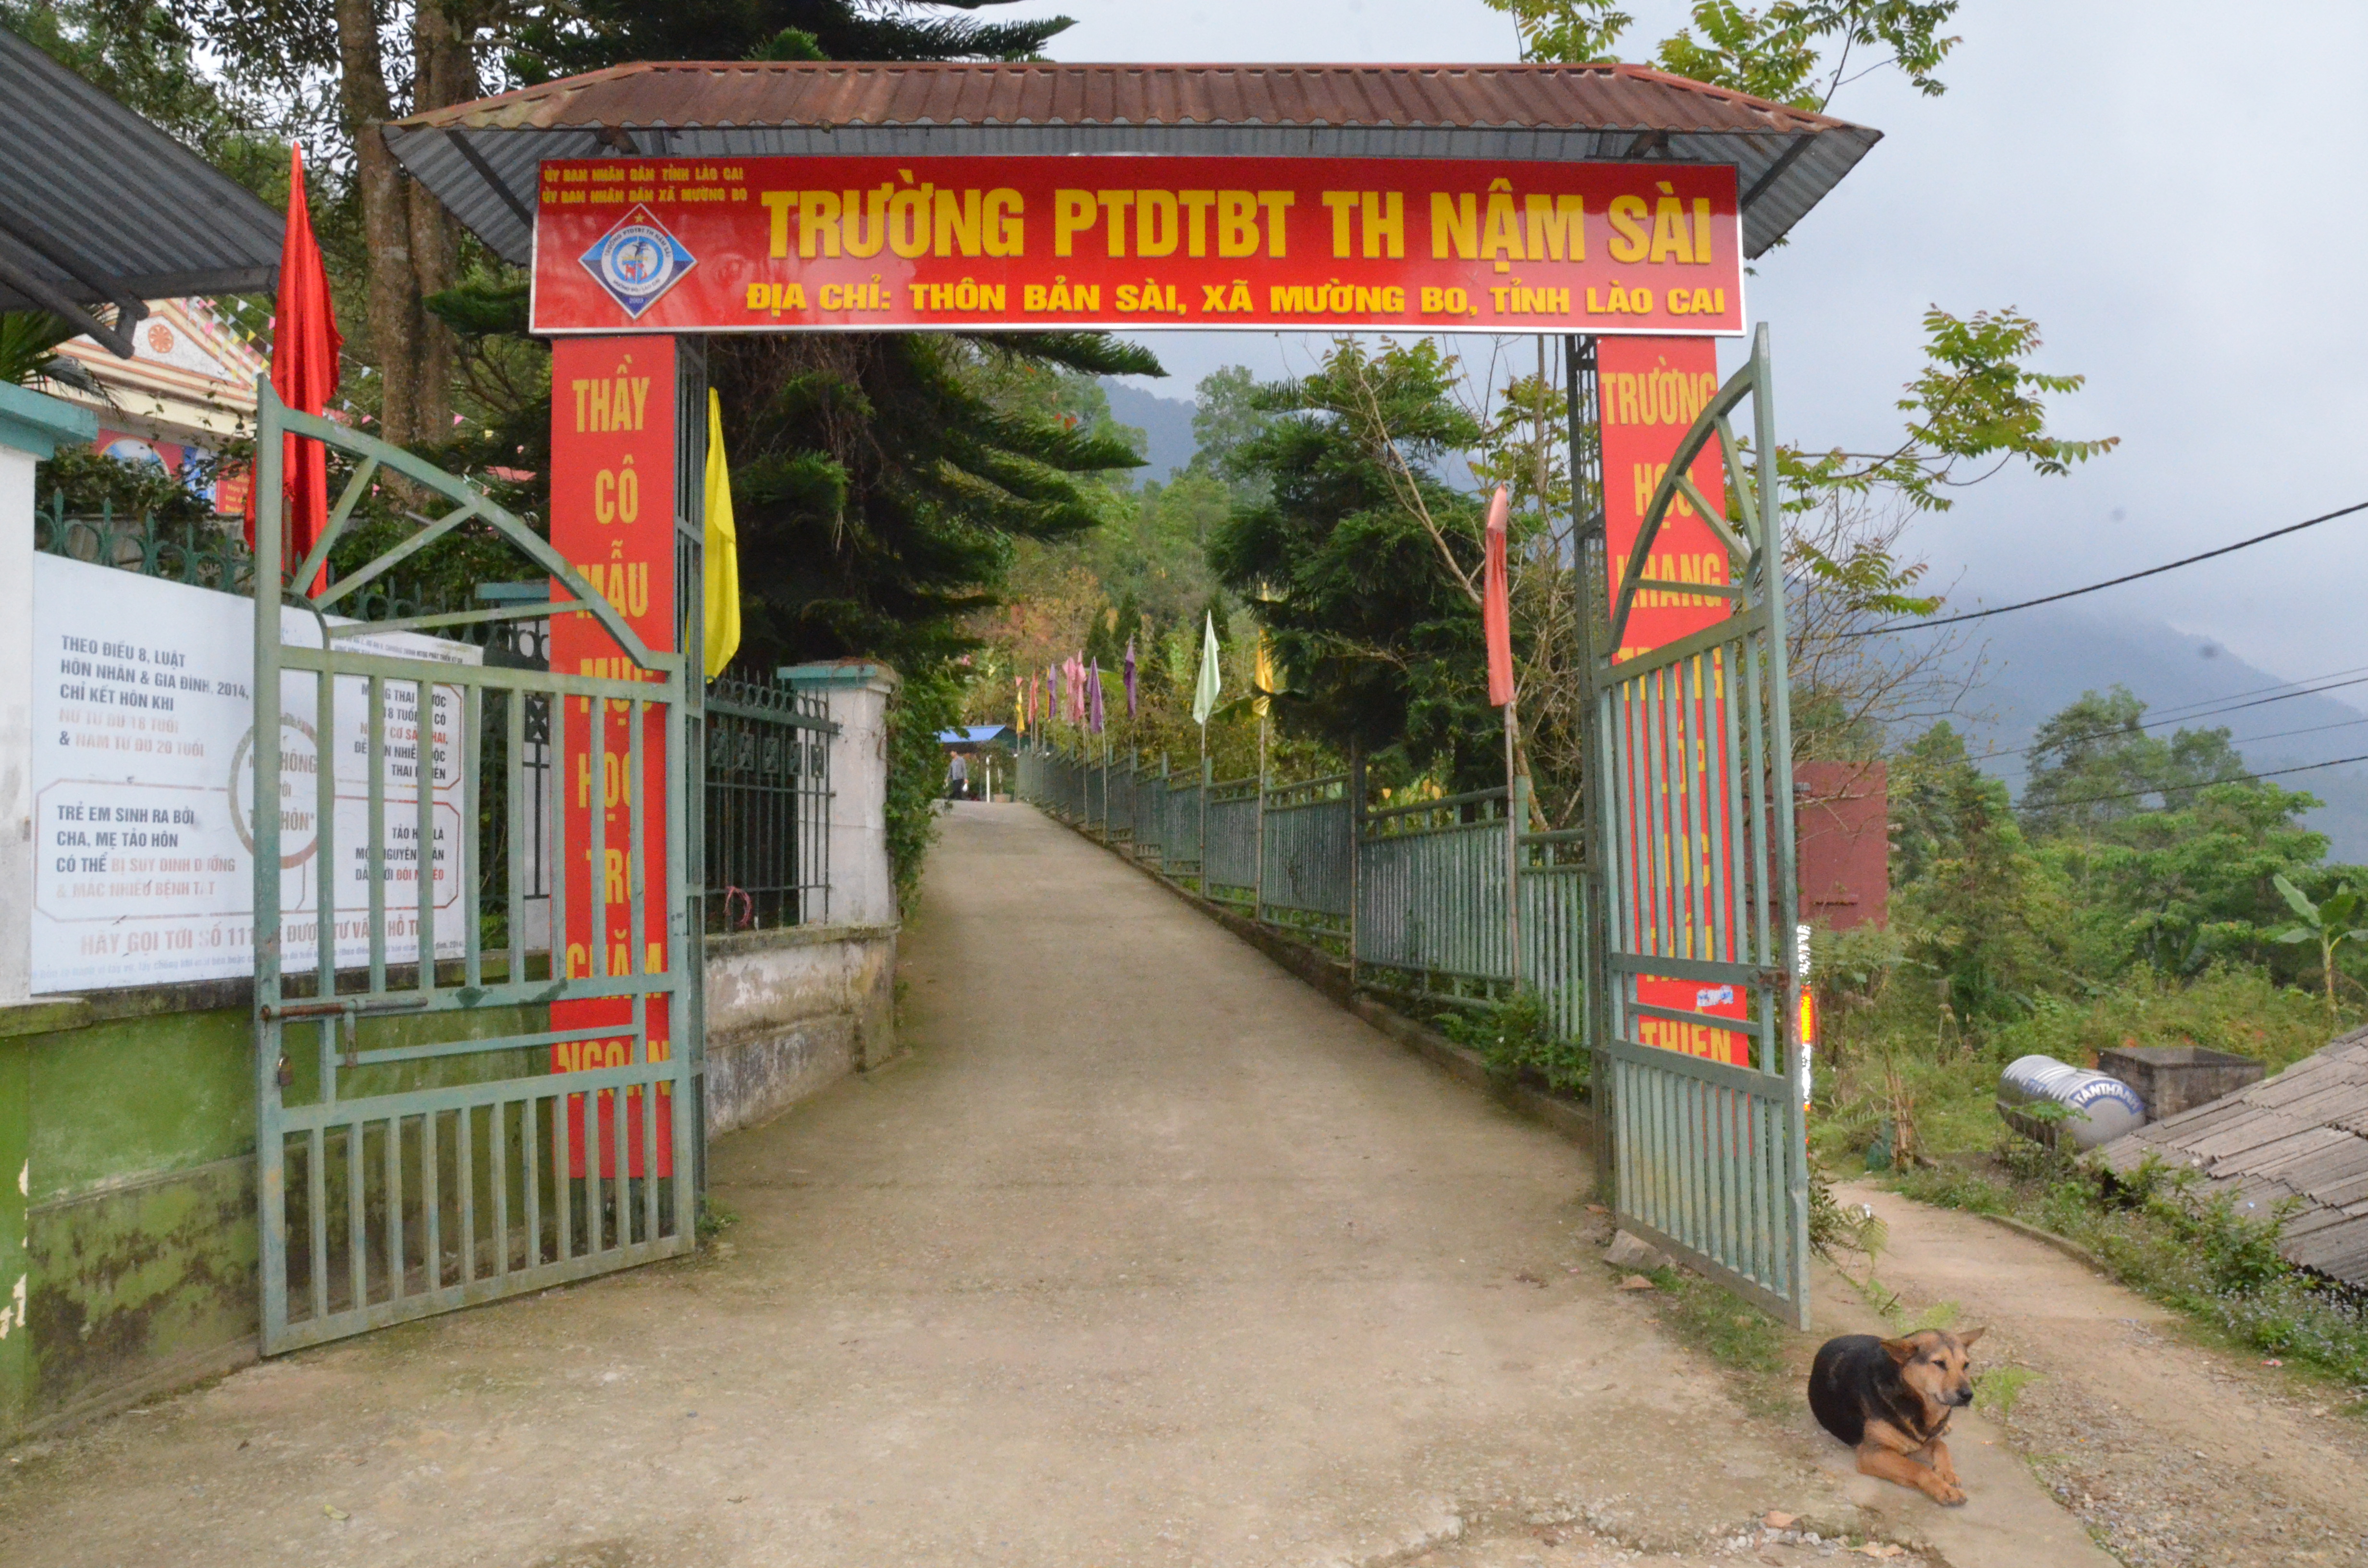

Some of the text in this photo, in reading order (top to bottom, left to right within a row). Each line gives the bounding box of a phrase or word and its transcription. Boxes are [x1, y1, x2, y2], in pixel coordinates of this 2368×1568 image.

[695, 164, 717, 181] LÀO
[723, 167, 743, 181] CAI
[761, 169, 1712, 273] TRƯỜNG PTDTBT TH NẬM SÀI
[746, 273, 1725, 318] ĐỊA CHỈ: THÔN BẢN SÀI, XÃ MƯỜNG BO, TỈNH LÀO CAI
[572, 354, 651, 432] THẦY
[595, 454, 638, 525] CÔ
[62, 635, 98, 655] THEO
[155, 649, 186, 671] LUẬT
[61, 658, 91, 677] HÔN
[96, 663, 136, 683] NHÂN
[140, 671, 149, 685] &
[155, 672, 176, 689] GIA
[217, 682, 249, 700] 2014,
[60, 680, 174, 711] CHỈ KẾT HÔN KHI
[395, 689, 414, 704] THAI
[434, 712, 446, 726] CÓ
[59, 731, 70, 746] &
[432, 731, 448, 746] HAI,
[280, 748, 318, 773] HÔNG
[432, 749, 446, 764] ỘC
[392, 764, 412, 777] THAI
[57, 801, 84, 821] TRẺ
[89, 807, 111, 822] EM
[115, 807, 148, 823] SINH
[153, 808, 169, 824] RA
[57, 827, 179, 850] CHA, MẸ TẢO HÔN
[433, 826, 444, 840] LÀ
[56, 854, 76, 873] CÓ
[81, 851, 109, 873] THỂ
[129, 858, 156, 872] SUY
[193, 881, 216, 895] TT
